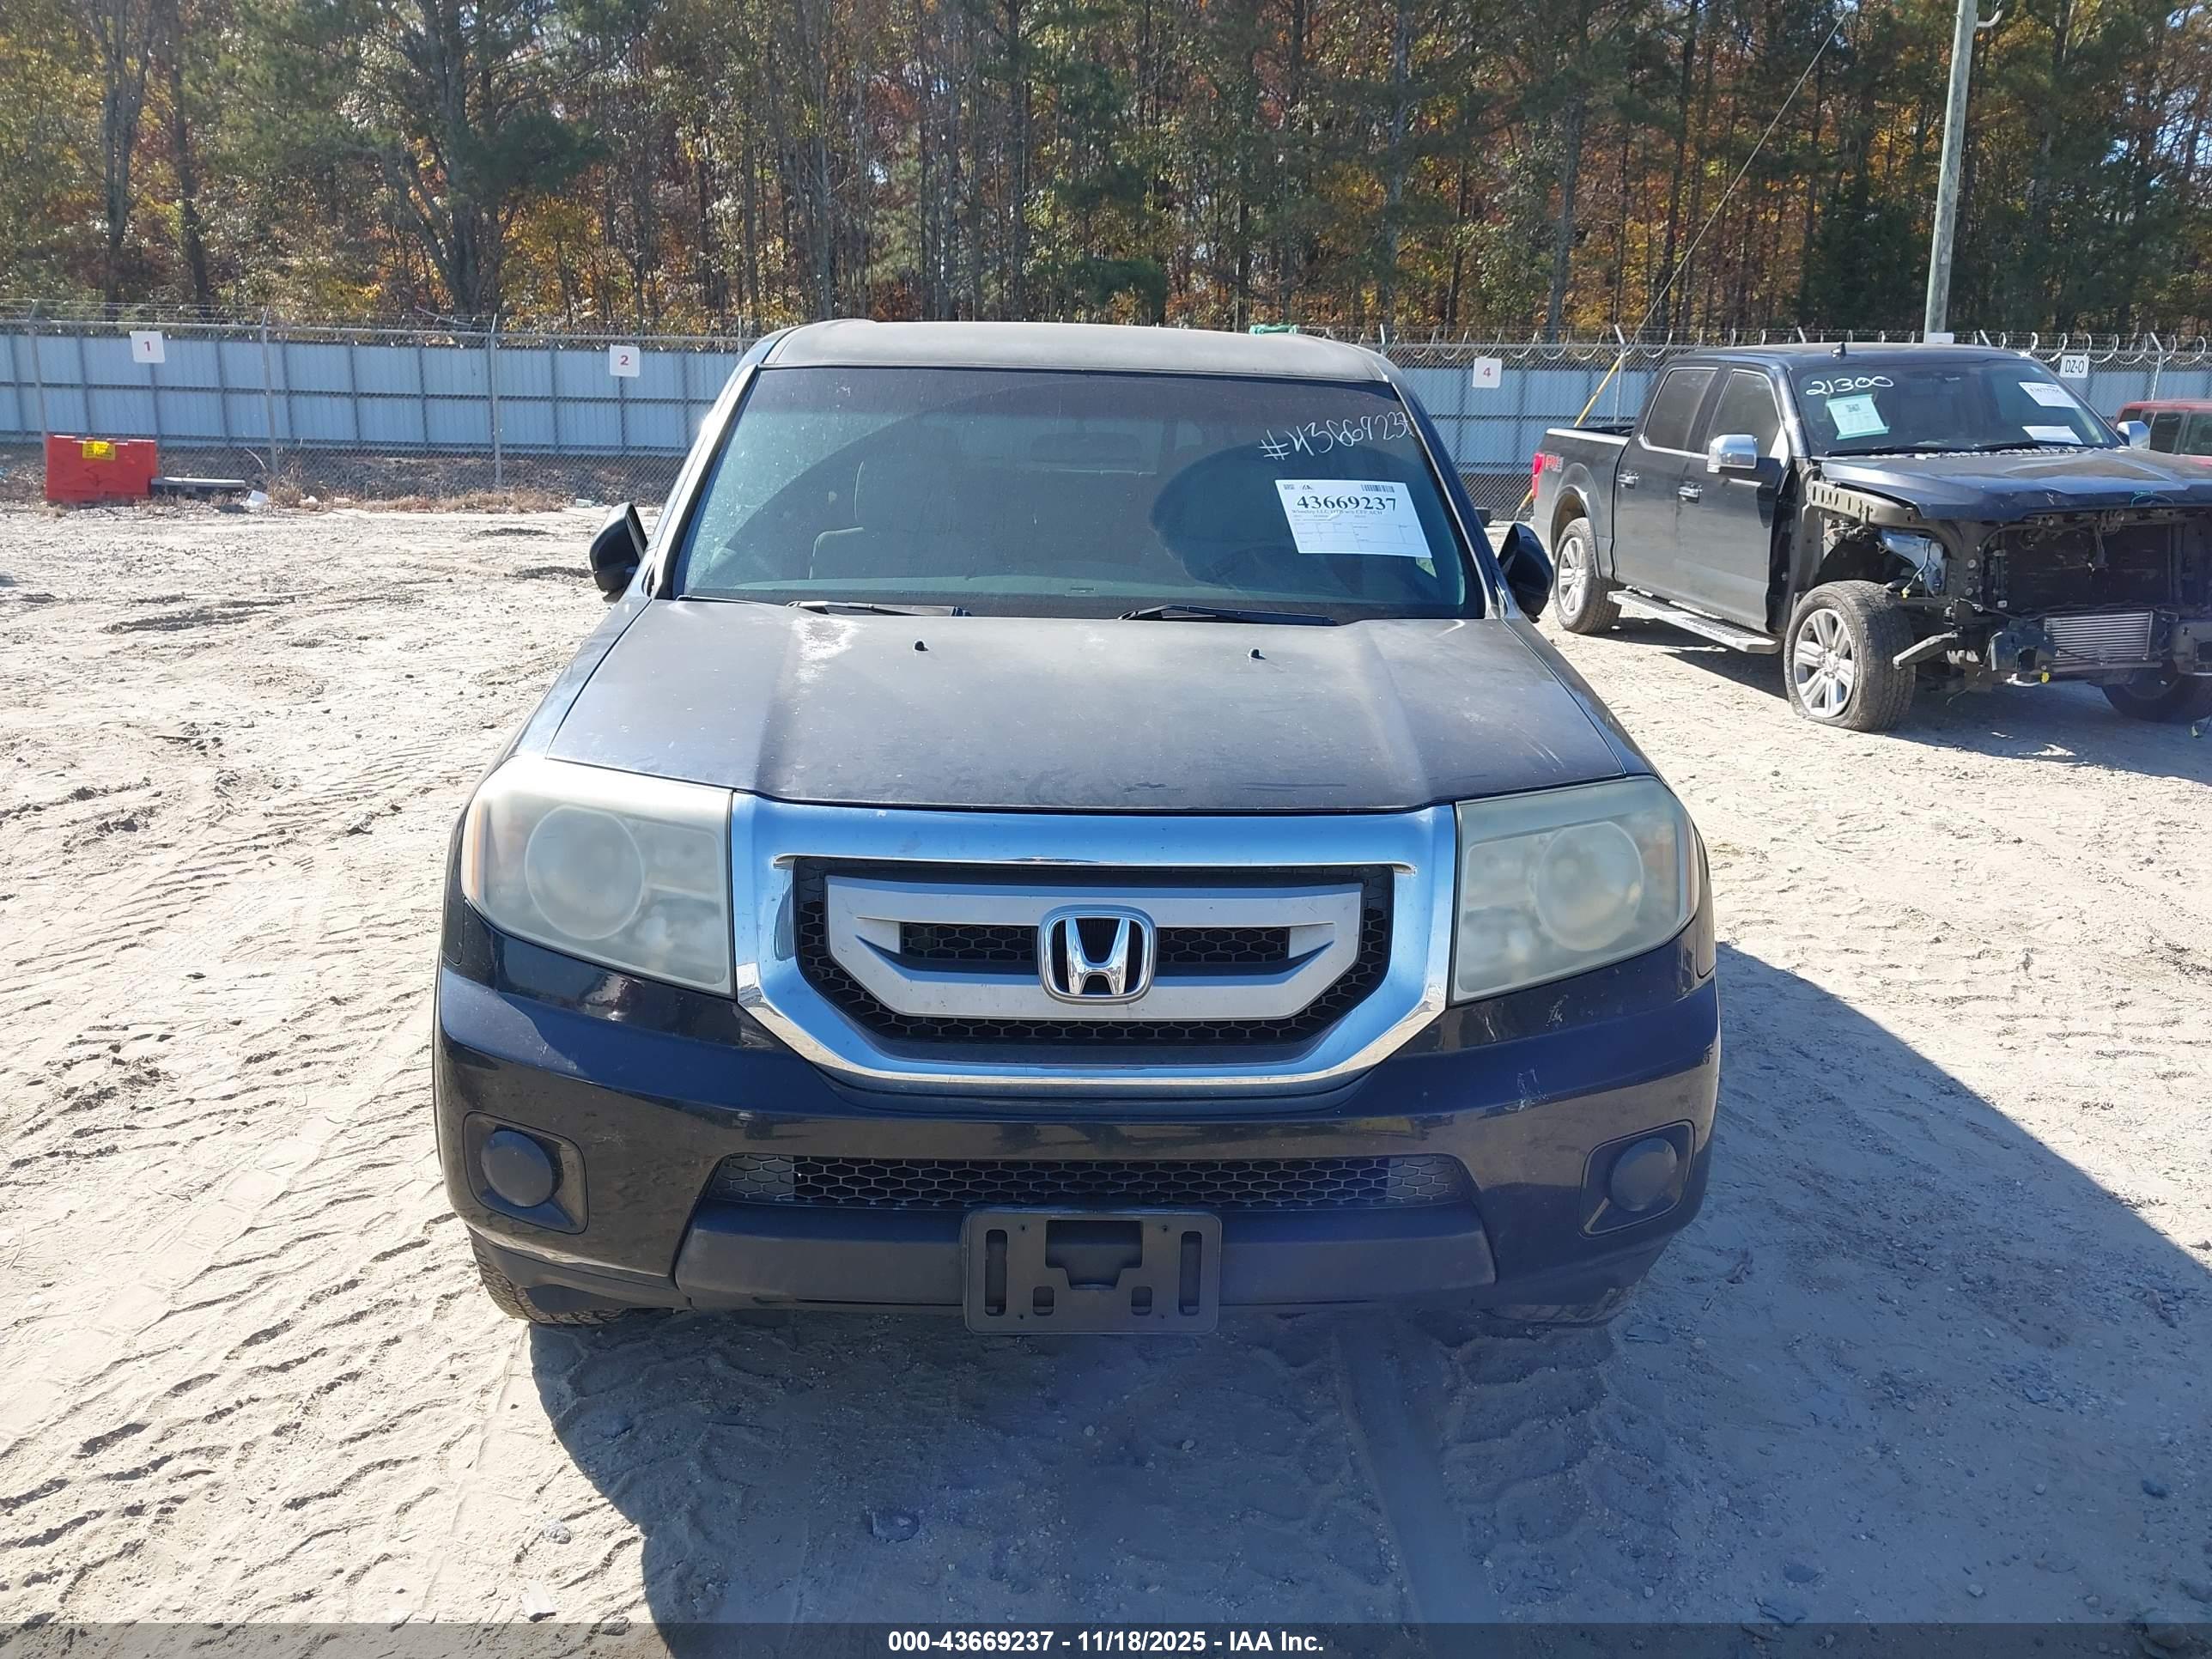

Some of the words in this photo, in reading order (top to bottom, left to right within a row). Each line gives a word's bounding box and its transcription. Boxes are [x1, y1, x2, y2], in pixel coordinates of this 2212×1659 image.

[143, 340, 150, 352] 1
[620, 354, 629, 366] 2
[1483, 367, 1492, 378] 4
[1805, 375, 1894, 395] 21300
[1258, 411, 1415, 461] #43669237
[1297, 495, 1397, 512] 43669237
